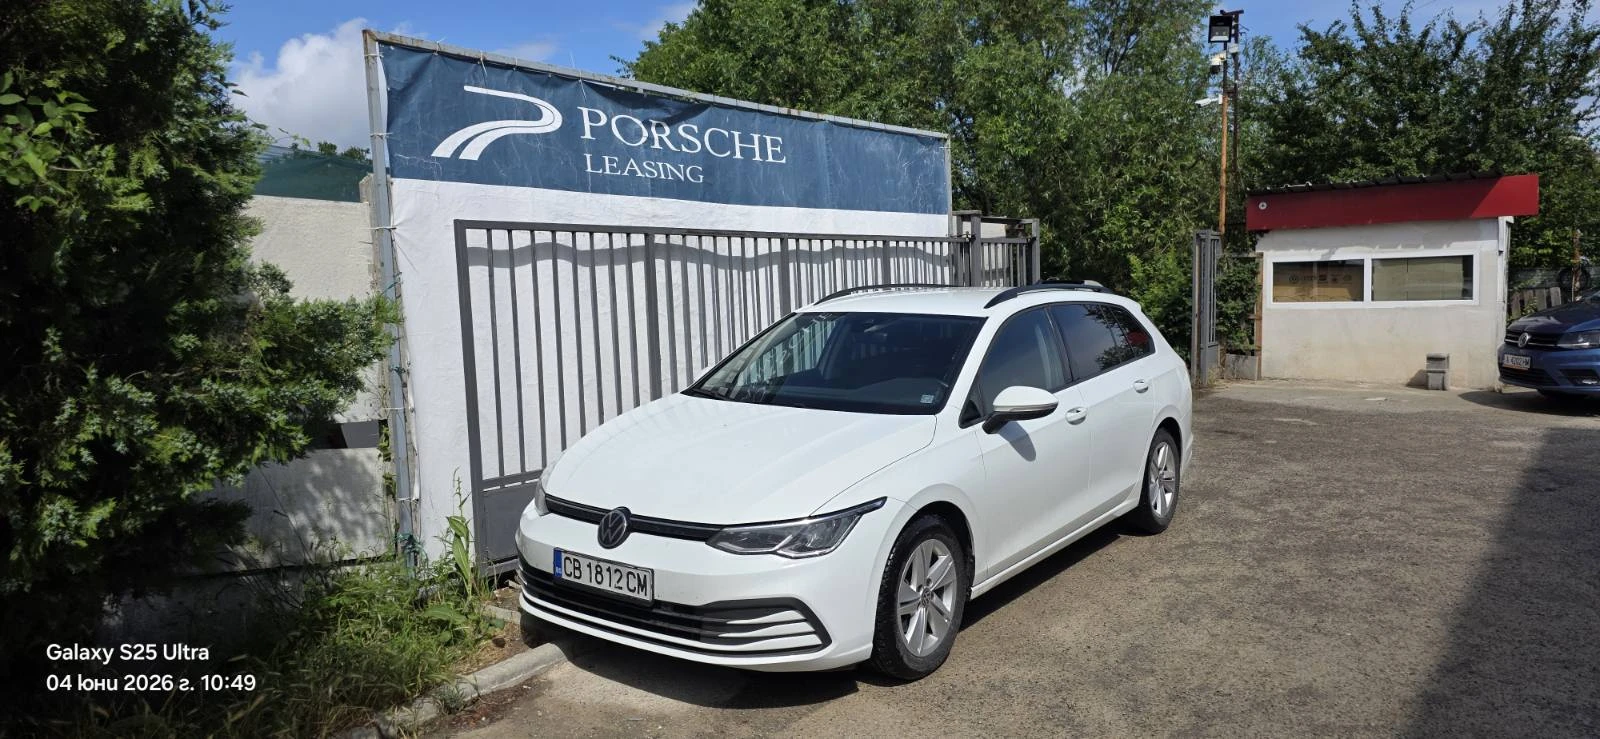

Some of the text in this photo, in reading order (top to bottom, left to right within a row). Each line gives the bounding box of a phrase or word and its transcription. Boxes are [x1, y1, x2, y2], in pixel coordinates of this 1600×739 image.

[577, 106, 786, 164] PORSCHE
[584, 153, 704, 183] LEASING
[563, 556, 648, 597] CB 1812 CM
